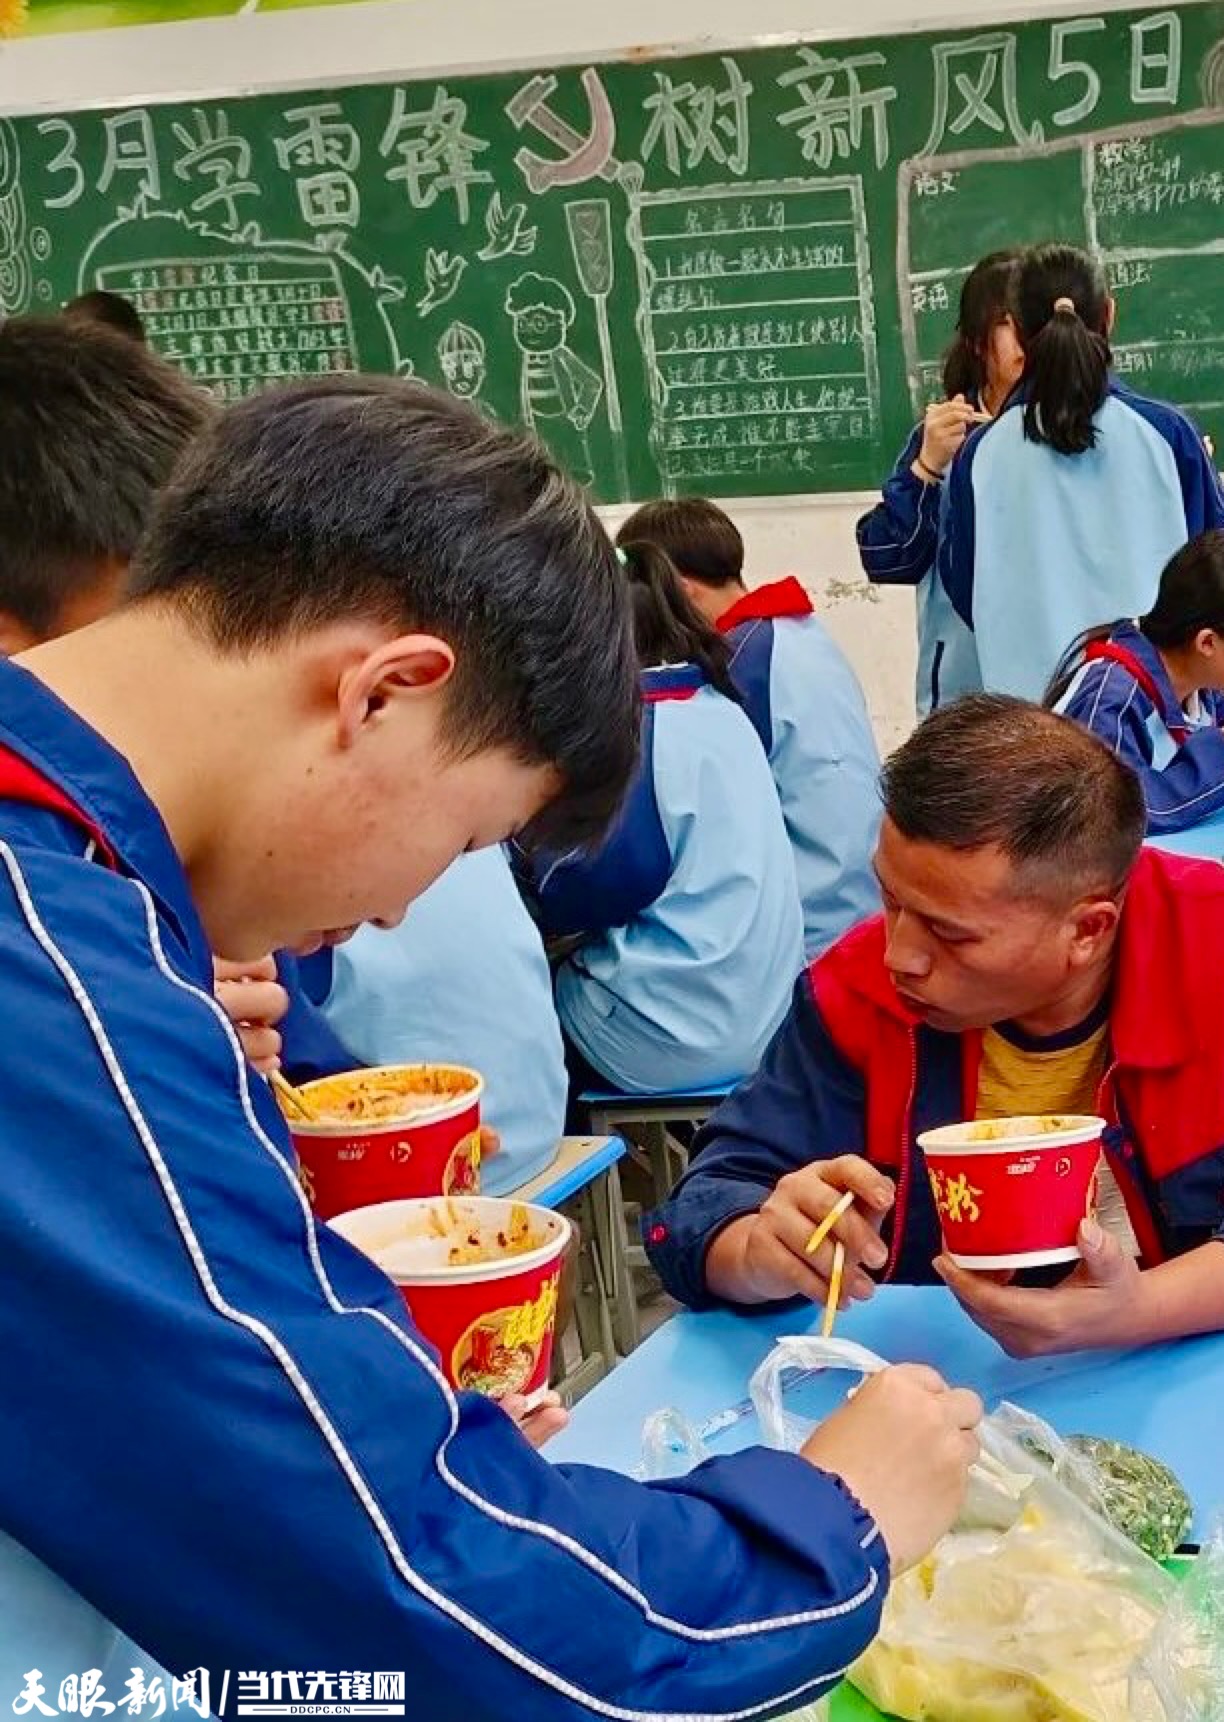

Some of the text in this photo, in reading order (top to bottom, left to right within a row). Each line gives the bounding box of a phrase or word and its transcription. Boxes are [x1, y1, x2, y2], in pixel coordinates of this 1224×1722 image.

[37, 10, 1183, 229] 3月学雷锋 树新风5日
